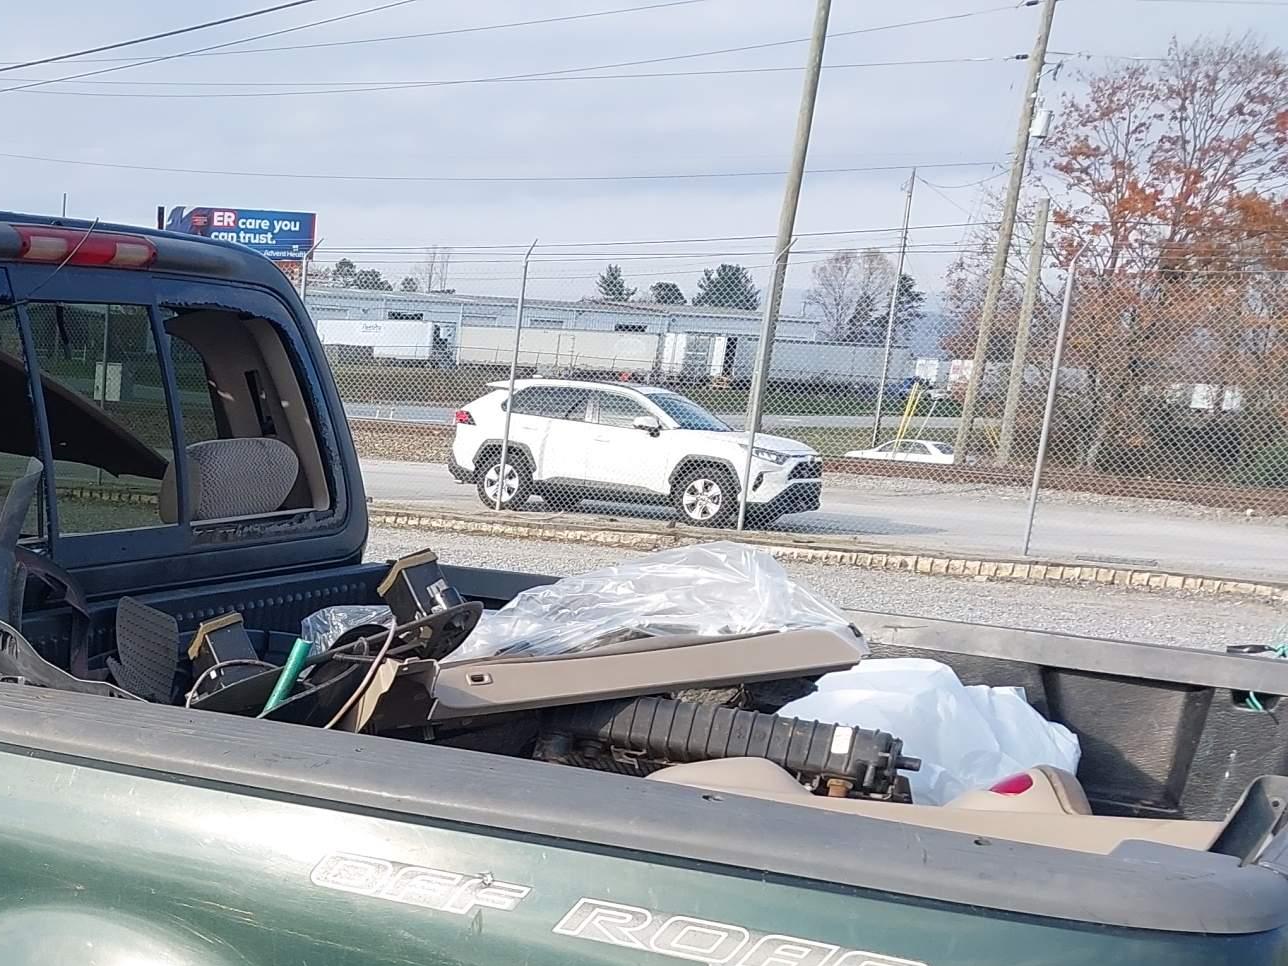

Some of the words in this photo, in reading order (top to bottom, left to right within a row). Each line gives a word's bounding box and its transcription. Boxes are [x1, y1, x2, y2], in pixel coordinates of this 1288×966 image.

[213, 211, 236, 227] ER
[238, 218, 270, 230] care
[273, 219, 300, 233] you
[210, 230, 237, 243] can
[239, 231, 277, 245] trust.
[310, 850, 535, 915] OFF
